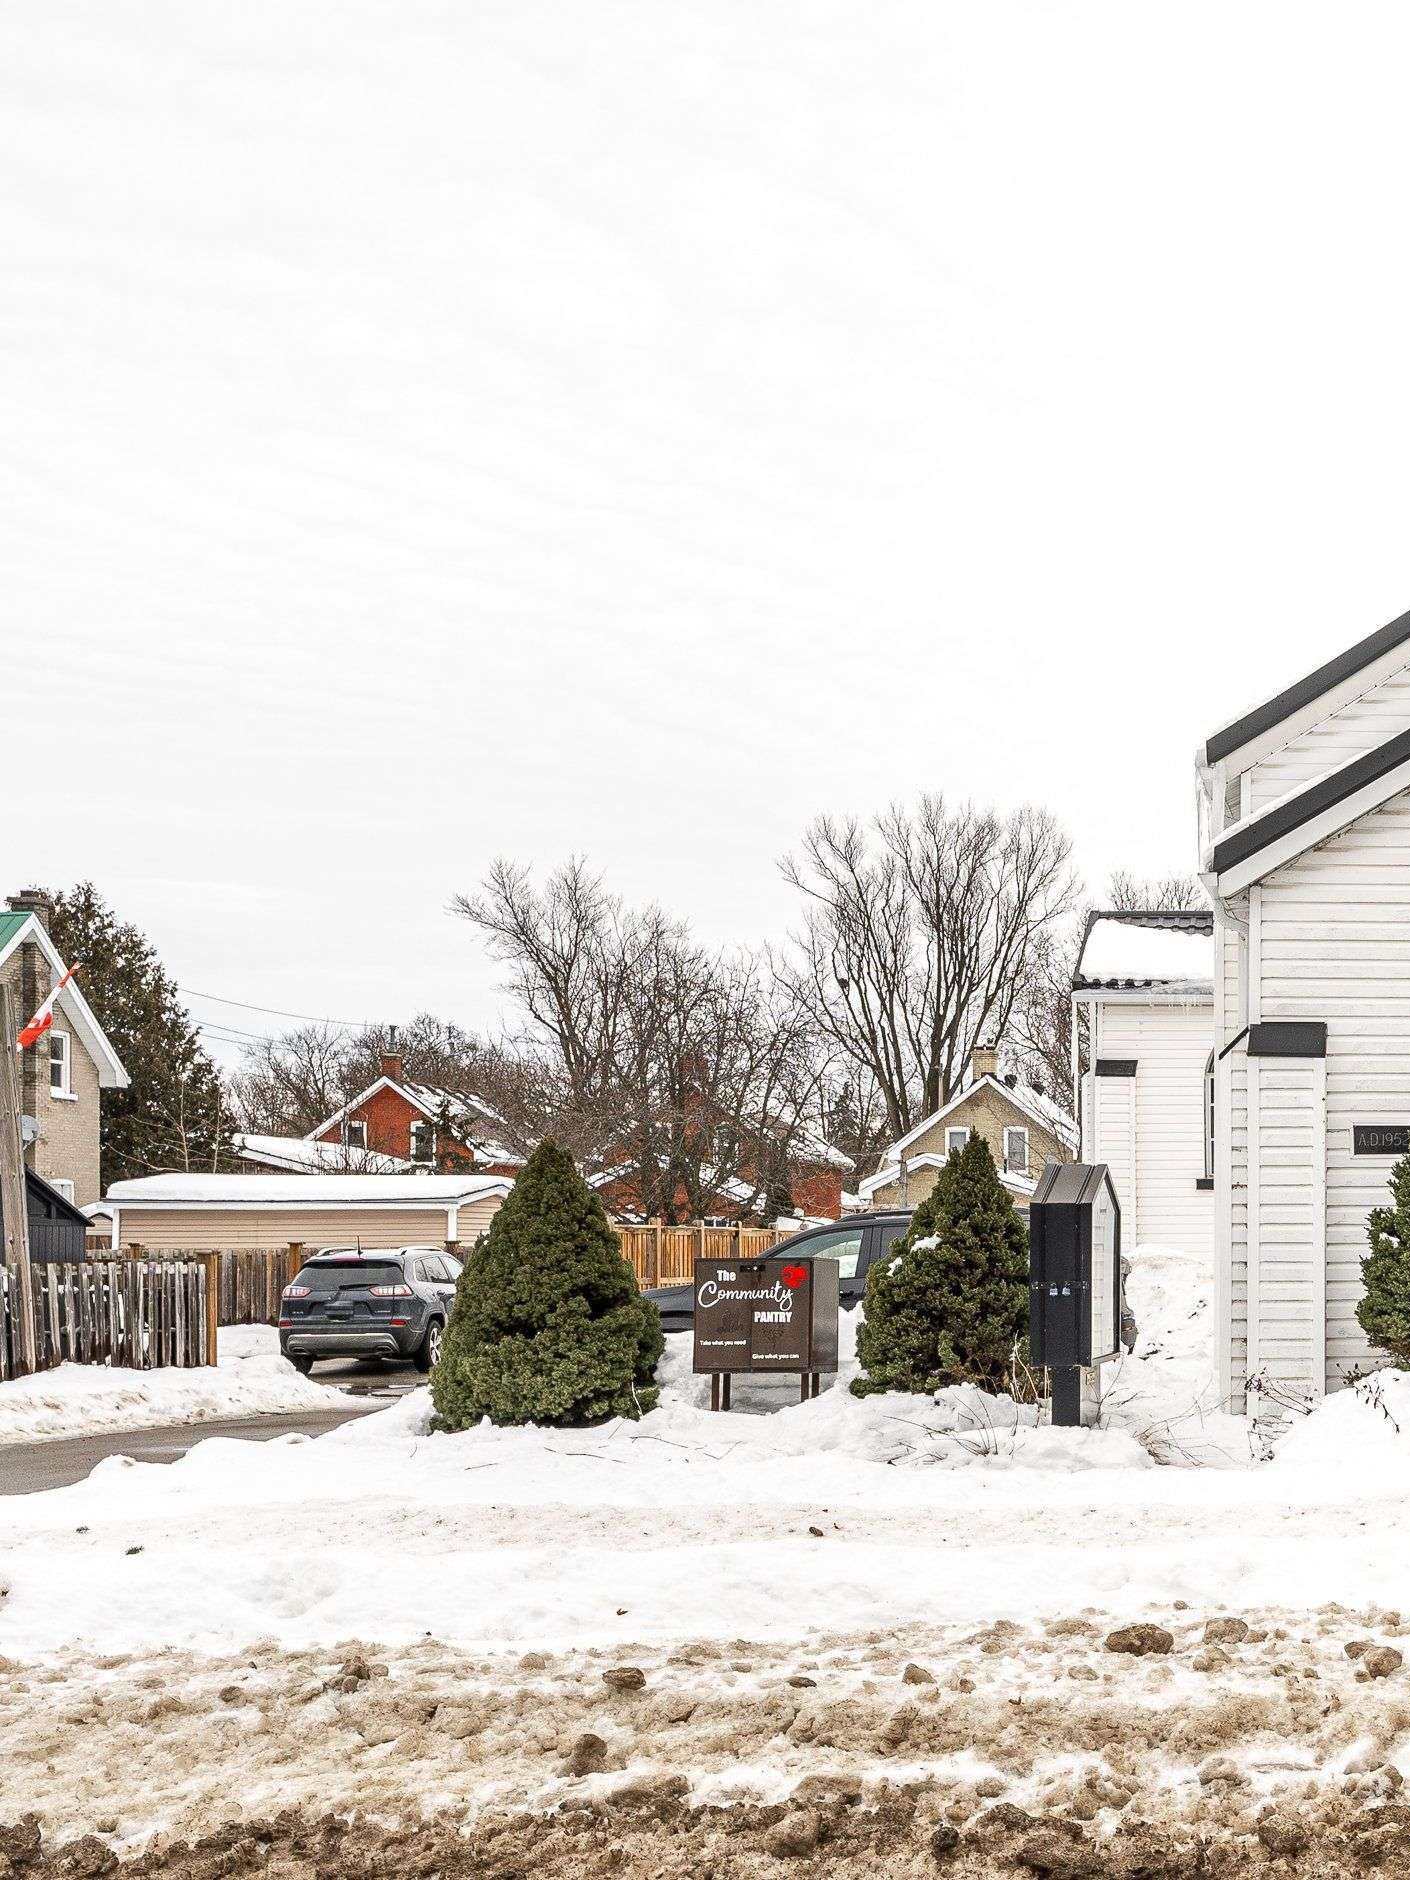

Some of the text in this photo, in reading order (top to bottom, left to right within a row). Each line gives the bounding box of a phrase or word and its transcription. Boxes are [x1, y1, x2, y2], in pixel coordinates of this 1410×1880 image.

[716, 1269, 737, 1281] The
[698, 1280, 793, 1312] Community
[754, 1311, 793, 1323] PANTRY
